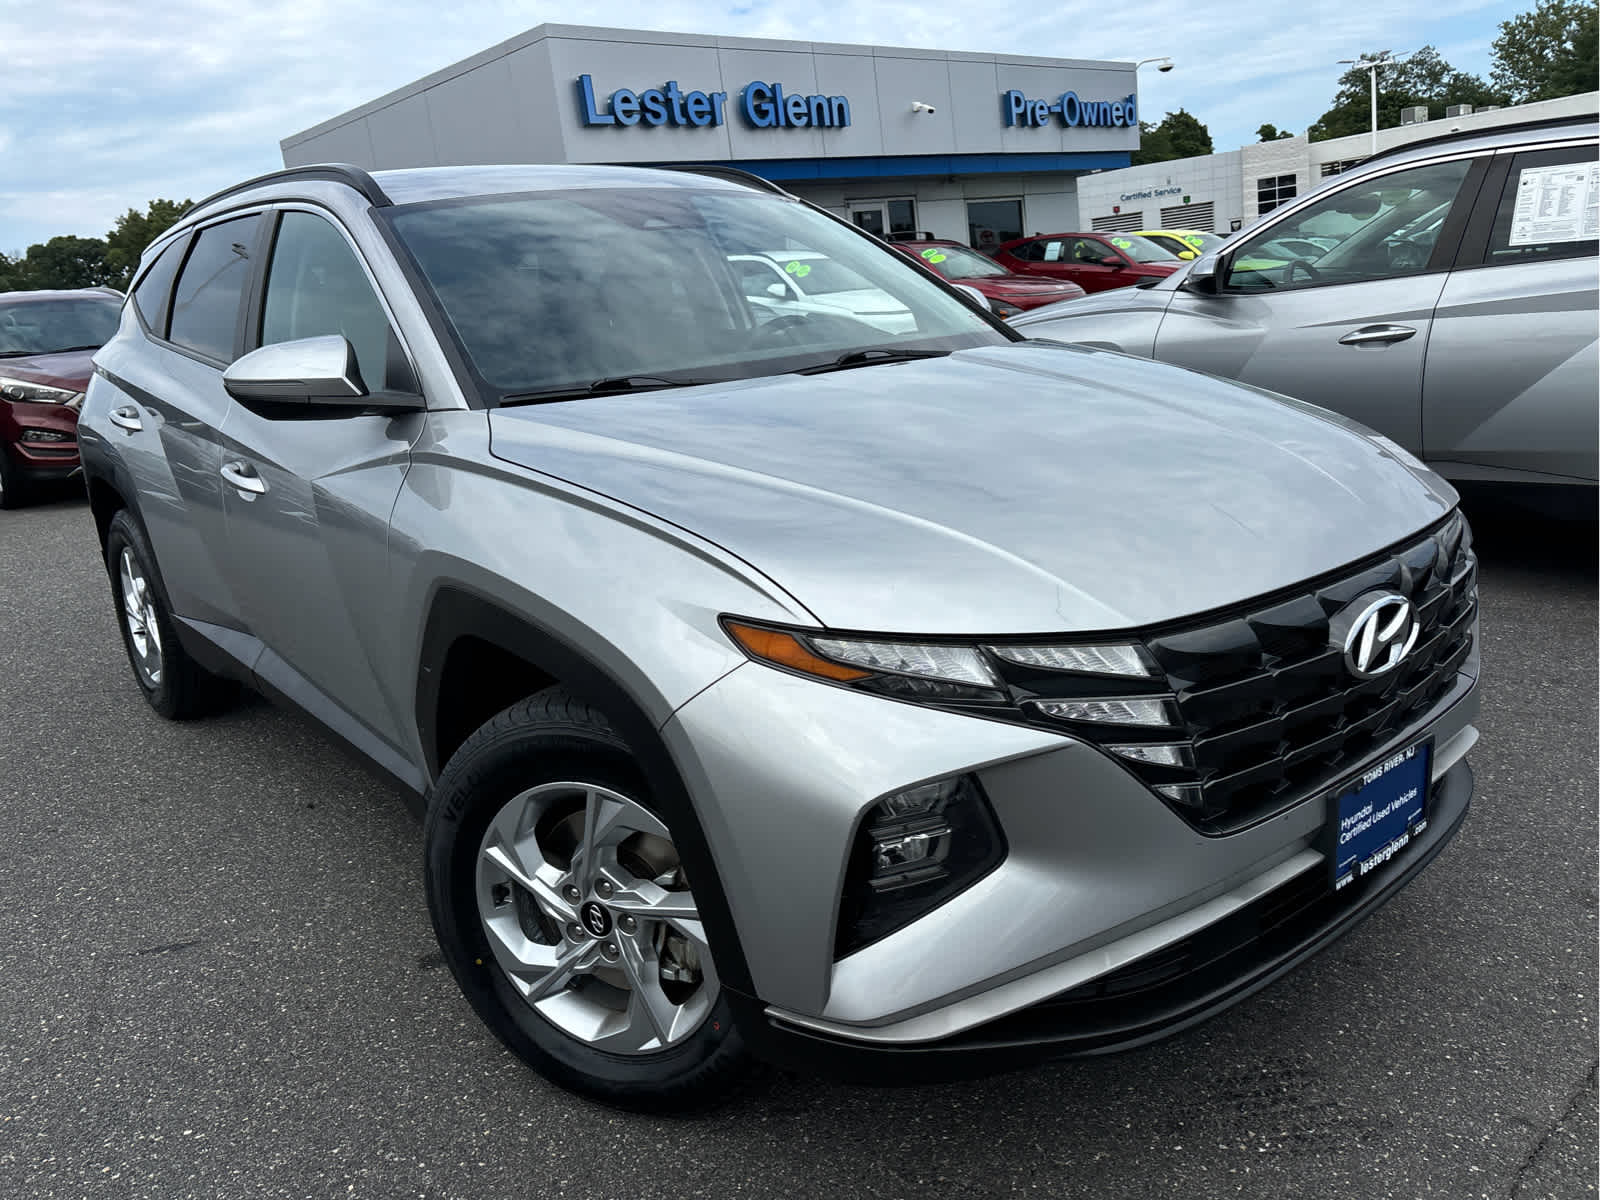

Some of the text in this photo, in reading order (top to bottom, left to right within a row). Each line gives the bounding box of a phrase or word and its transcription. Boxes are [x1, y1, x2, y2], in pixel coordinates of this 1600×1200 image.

[576, 74, 851, 127] Lester Glenn
[1004, 90, 1137, 127] Pre-Owned
[1120, 187, 1182, 201] Certified Service
[1363, 766, 1383, 785] TOMS
[1406, 746, 1415, 760] NJ
[1340, 787, 1417, 844] Certified Used Vehicles
[1341, 800, 1373, 831] Hyundai
[1361, 834, 1409, 876] lesterglenn
